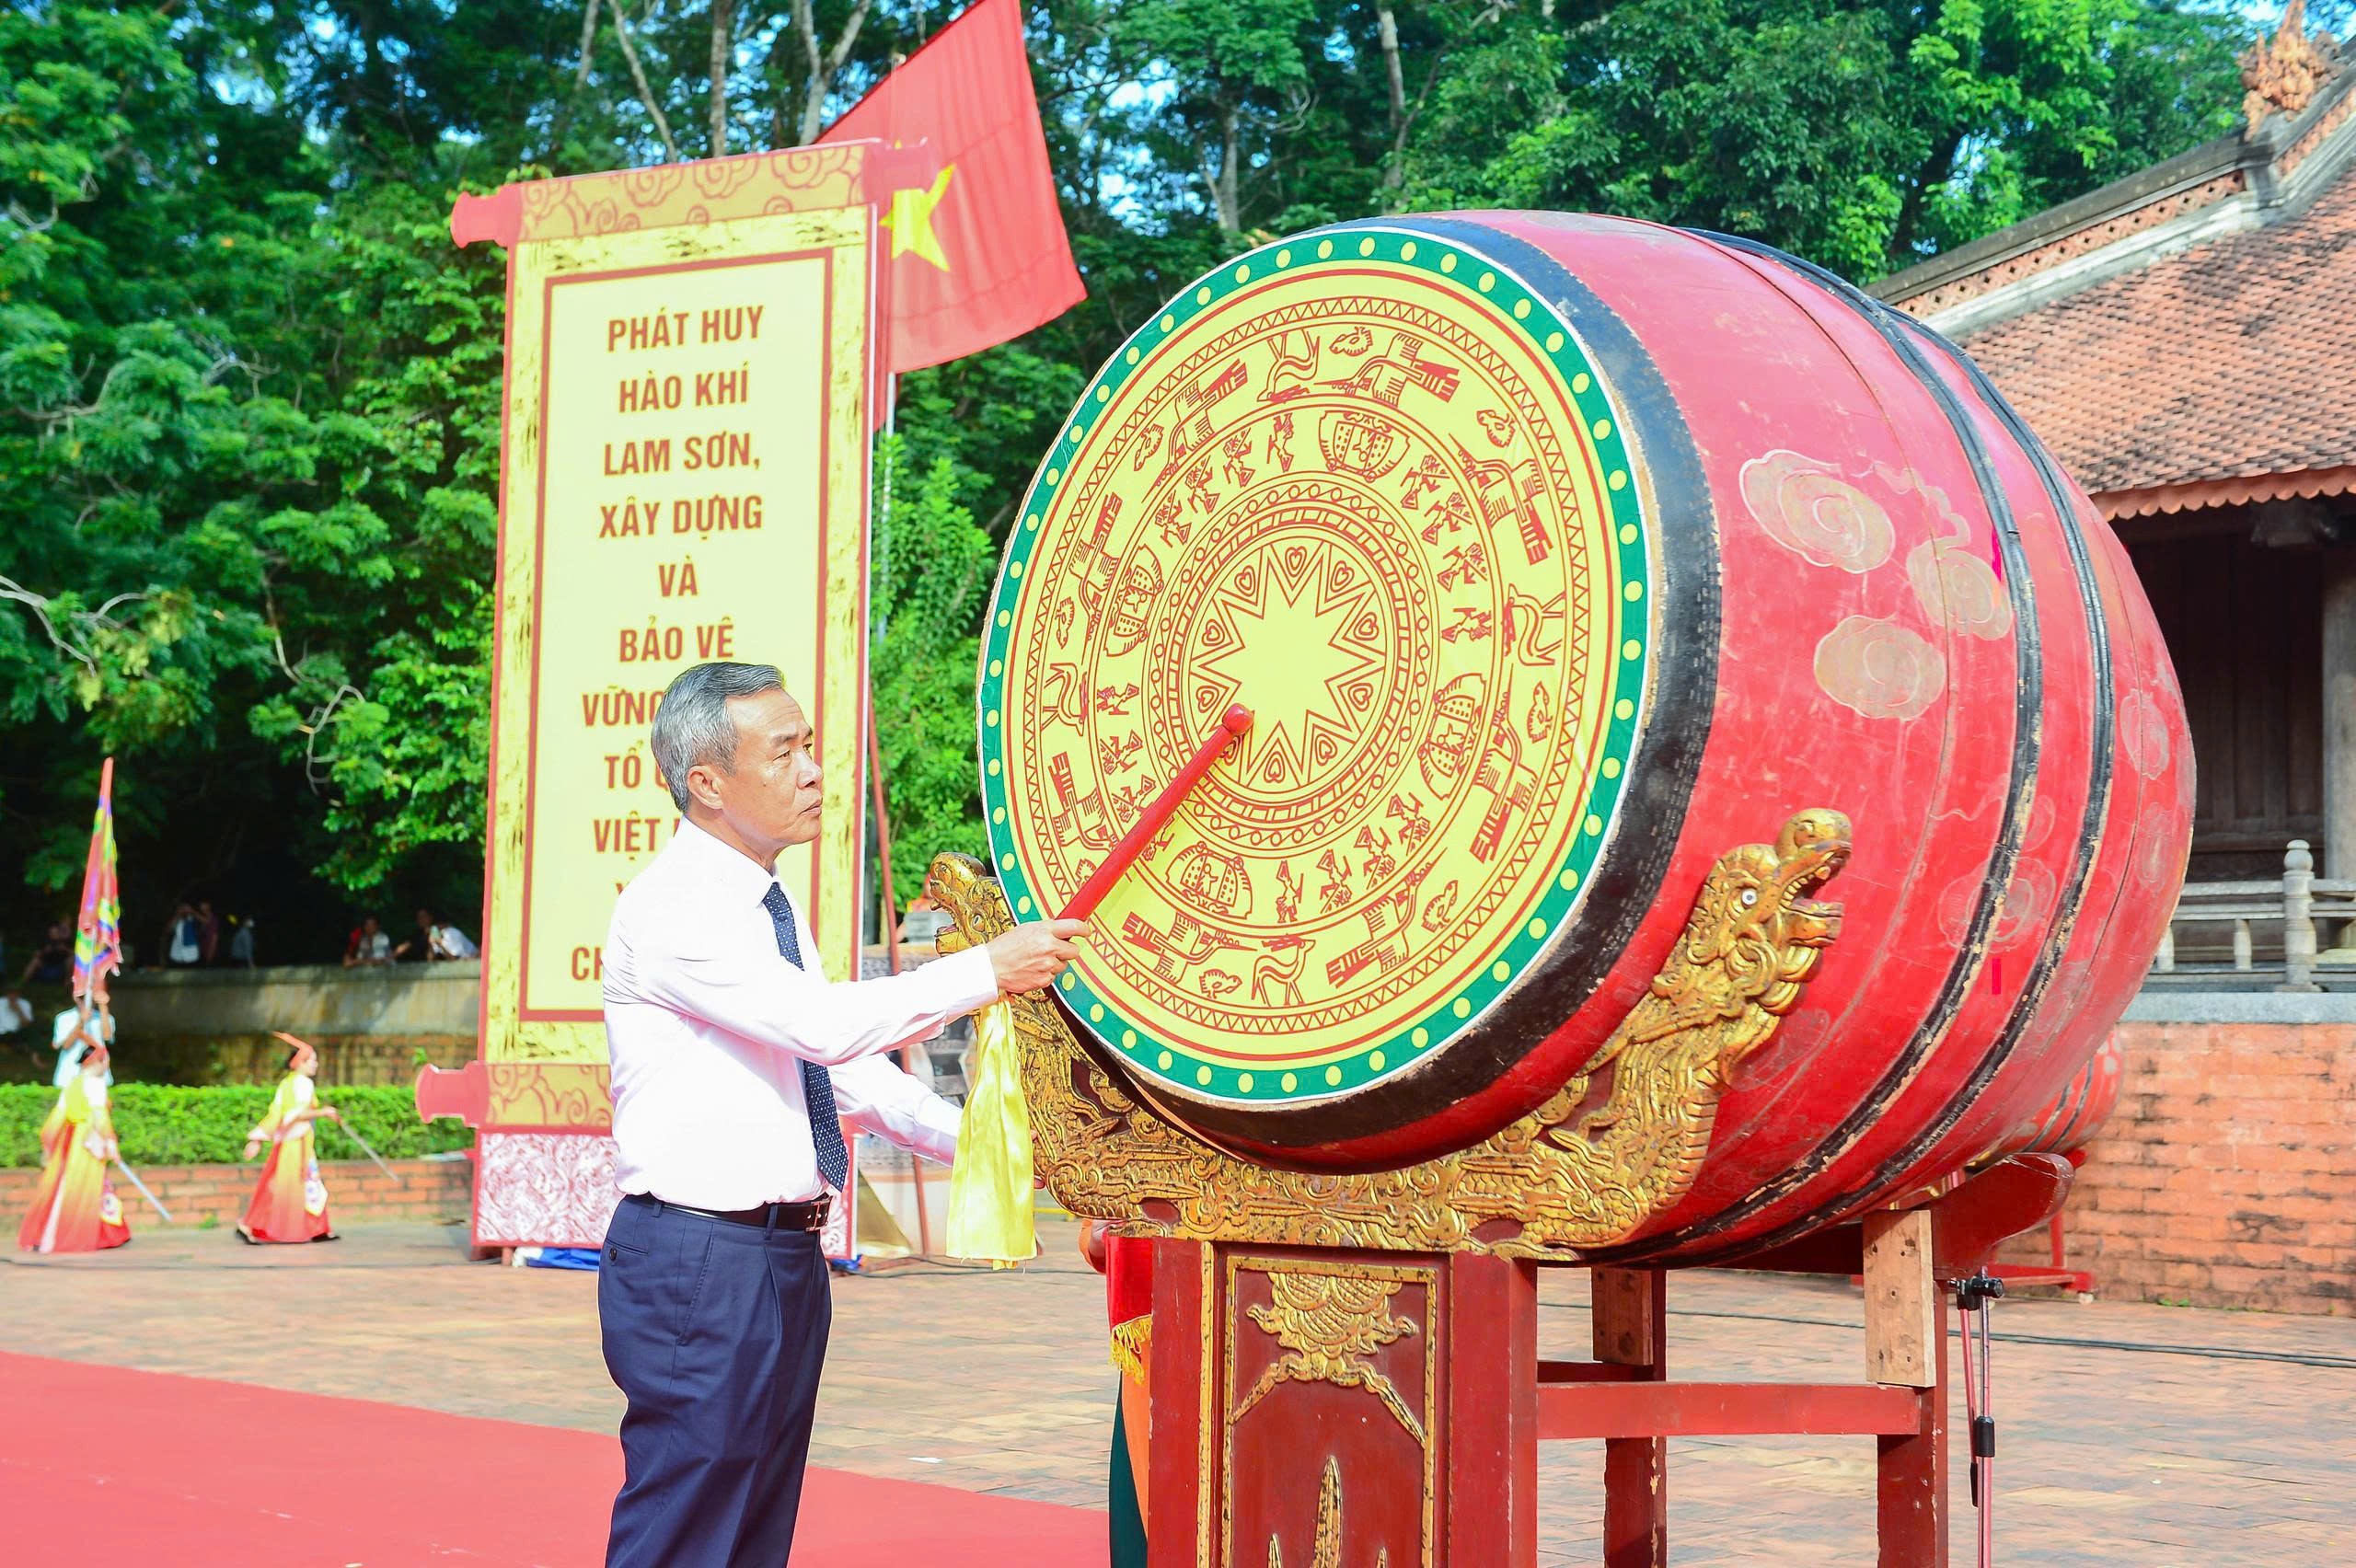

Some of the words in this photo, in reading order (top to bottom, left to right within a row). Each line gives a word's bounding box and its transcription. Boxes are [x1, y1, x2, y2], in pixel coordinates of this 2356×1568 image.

[609, 307, 688, 352] PHÁT
[702, 306, 763, 342] HUY
[620, 371, 681, 412] HÀO
[696, 363, 747, 406] KHÍ
[605, 440, 670, 475] LAM
[685, 432, 759, 469] SƠN,
[600, 497, 660, 537] XÂY
[674, 495, 761, 539] DỰNG
[659, 556, 697, 596] VÀ
[620, 616, 682, 662] BẢO
[604, 740, 643, 789] TỔ
[595, 811, 660, 859] VIỆT
